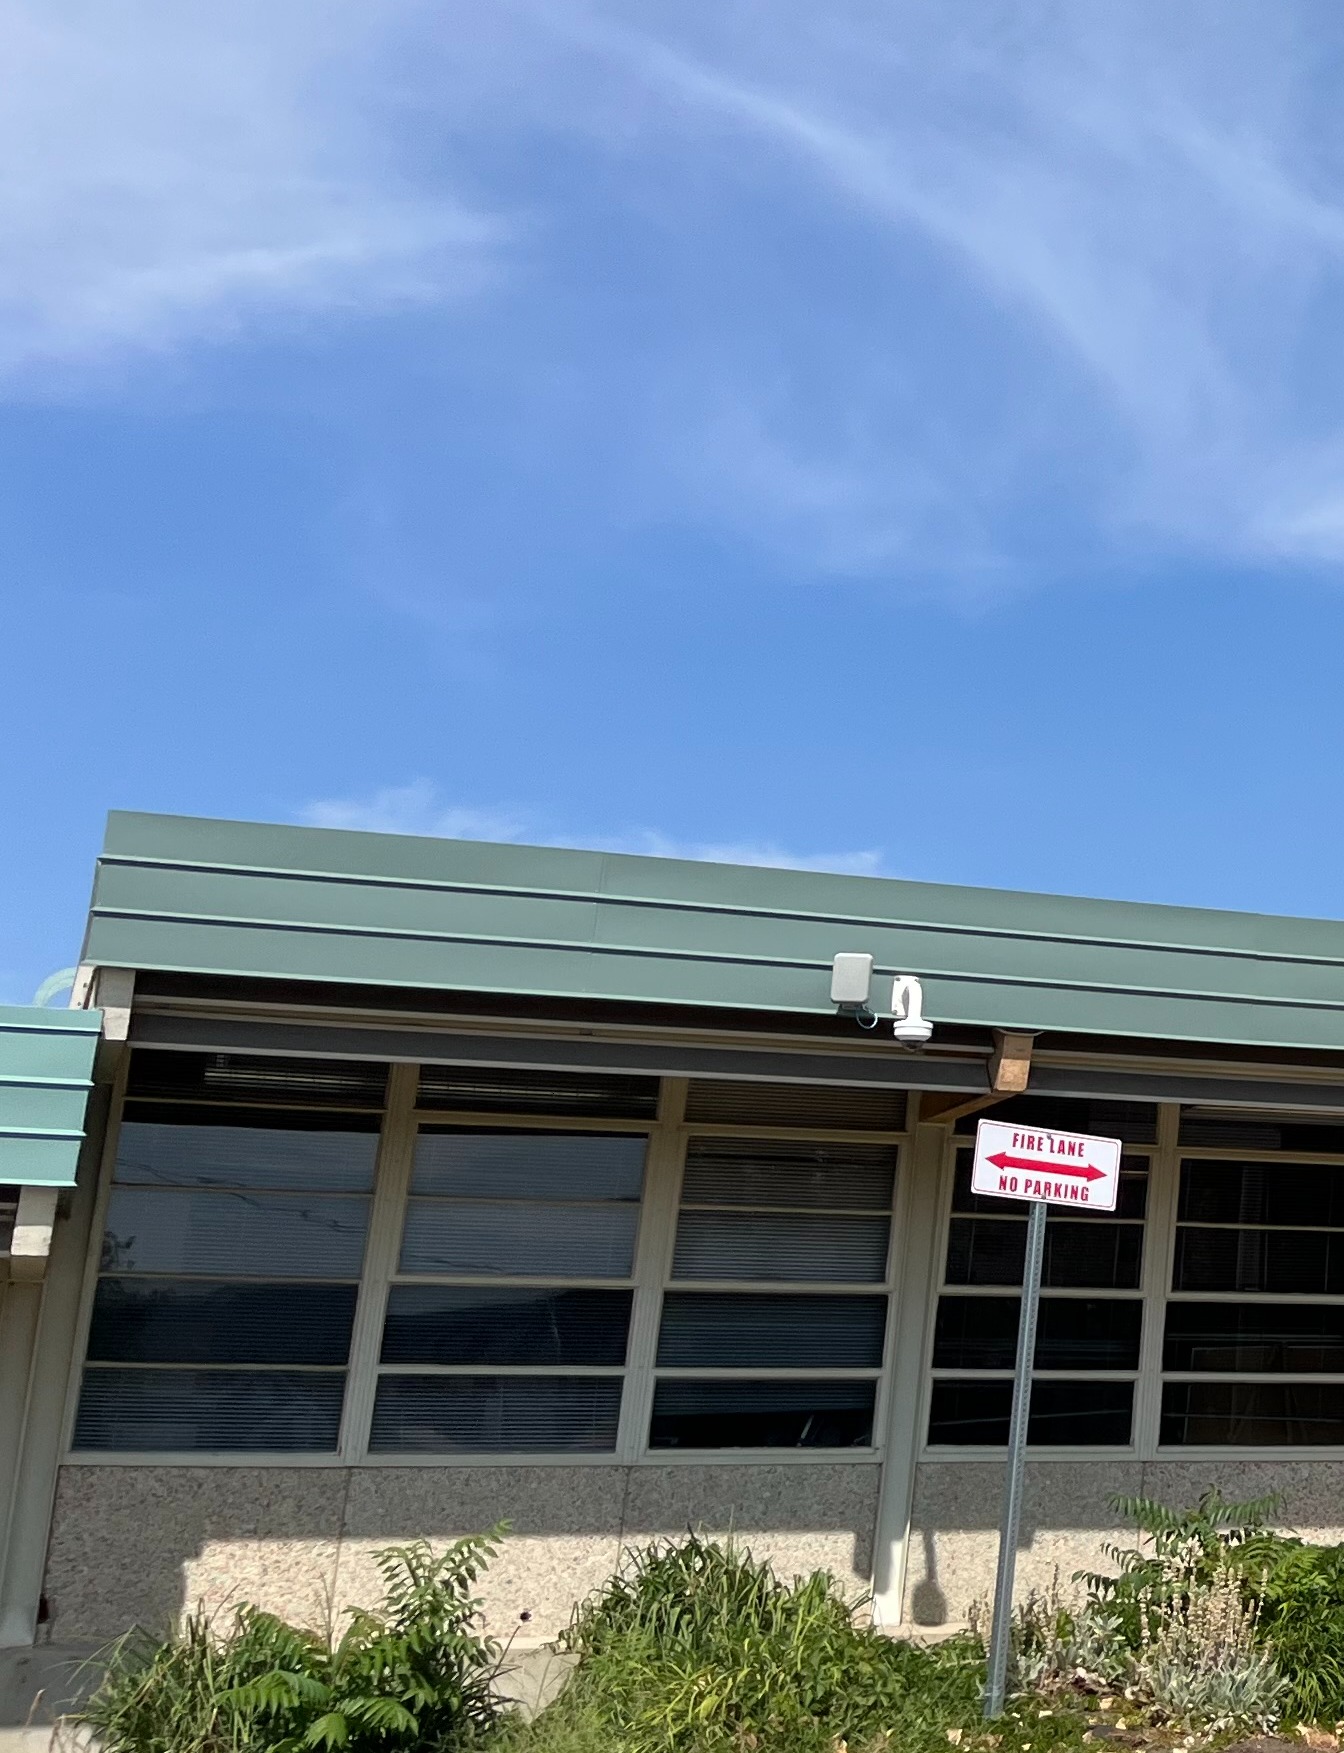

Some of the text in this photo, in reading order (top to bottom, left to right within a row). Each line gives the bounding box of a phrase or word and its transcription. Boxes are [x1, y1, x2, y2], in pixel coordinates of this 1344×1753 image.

[1012, 1132, 1085, 1157] FIRE LANE
[999, 1174, 1089, 1201] NO PARKING
